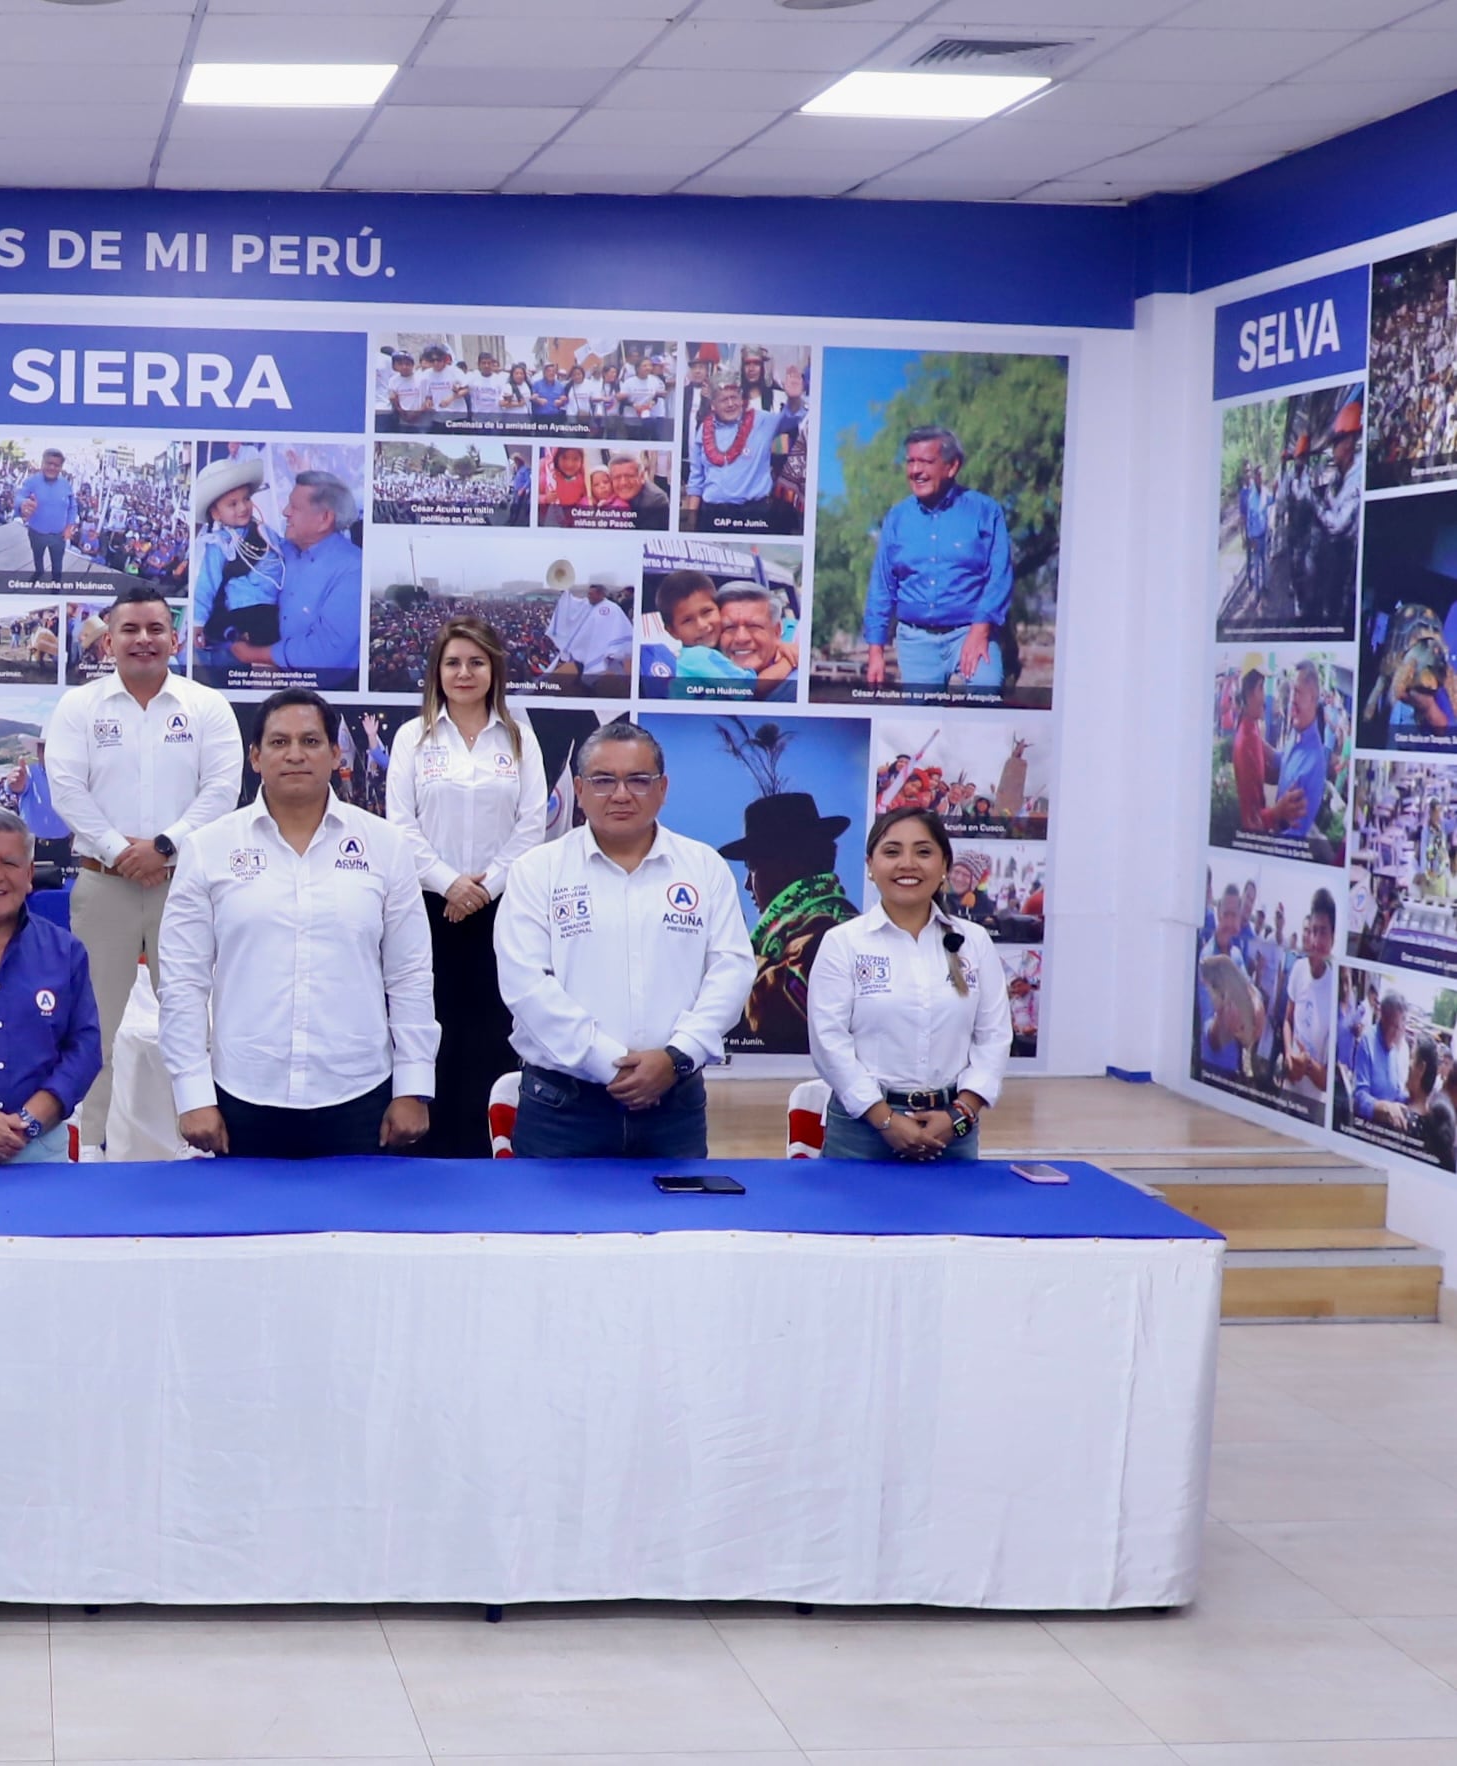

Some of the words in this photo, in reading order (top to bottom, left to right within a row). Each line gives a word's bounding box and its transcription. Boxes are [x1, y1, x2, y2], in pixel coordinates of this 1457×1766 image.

[48, 229, 122, 270] DE
[145, 232, 207, 273] MI
[232, 226, 396, 277] PERÚ.
[1238, 299, 1340, 372] SELVA
[9, 348, 292, 410] SIERRA
[484, 421, 494, 429] de
[496, 421, 504, 429] la
[714, 518, 731, 527] CAP
[8, 580, 33, 588] César
[34, 580, 61, 589] Acuña
[686, 686, 704, 694] CAP
[172, 717, 183, 728] A
[111, 725, 119, 734] 4
[345, 840, 360, 853] A
[674, 887, 692, 905] A
[577, 901, 588, 915] 5
[662, 912, 703, 928] ACUÑA
[877, 967, 886, 979] 3
